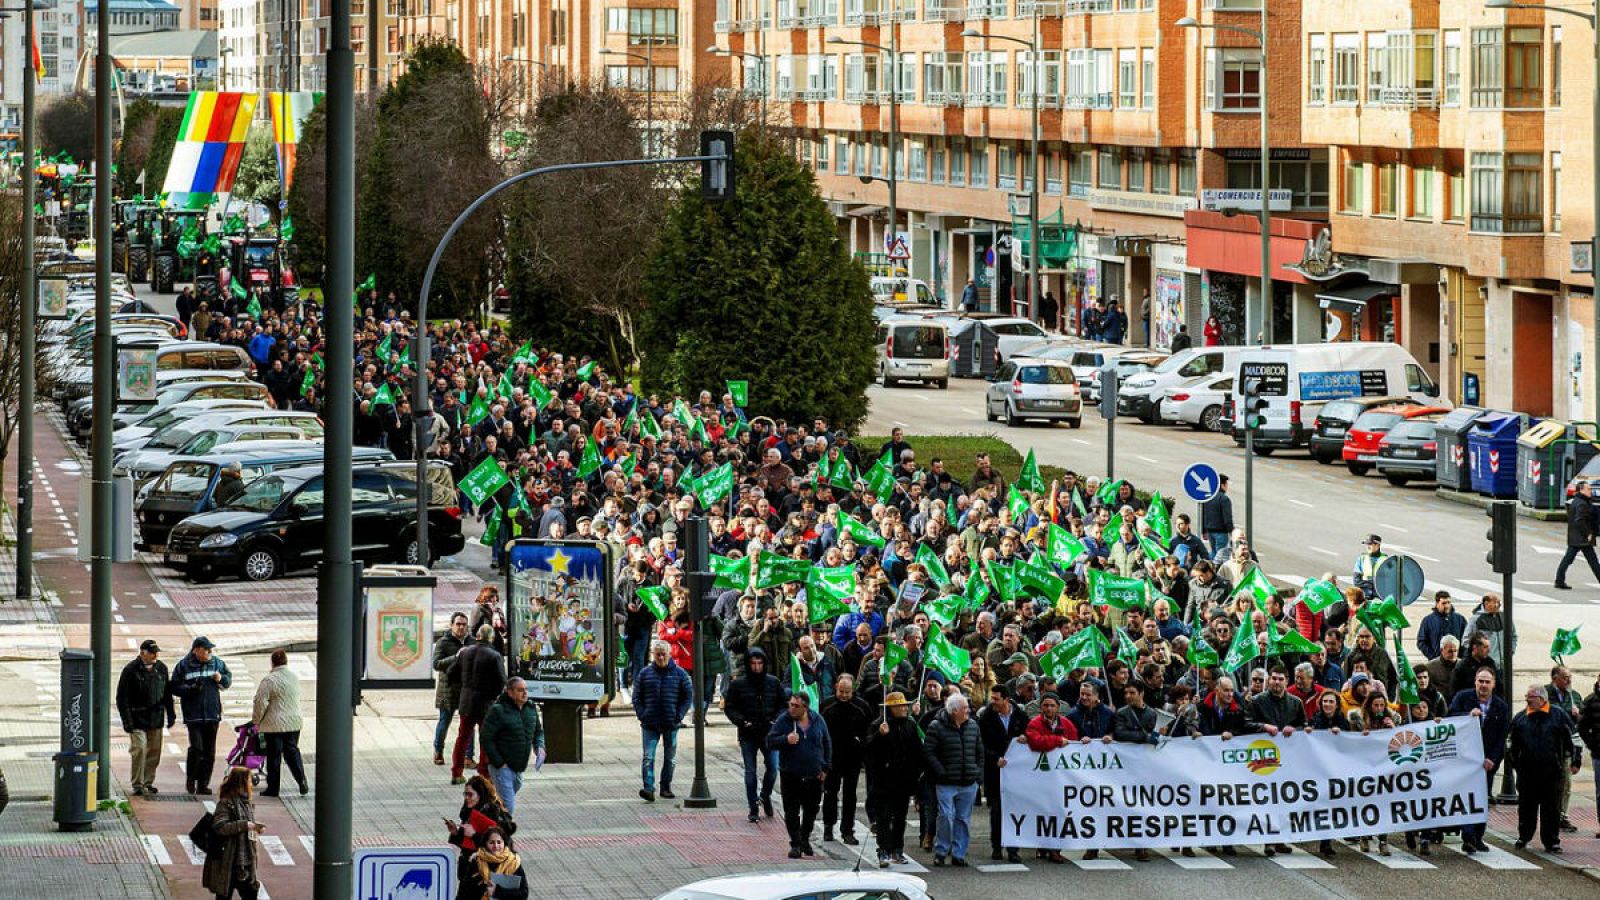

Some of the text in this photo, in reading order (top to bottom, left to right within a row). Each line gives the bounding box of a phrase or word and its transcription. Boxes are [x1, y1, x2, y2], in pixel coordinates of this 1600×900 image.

[1218, 191, 1290, 201] COMERCIO EERIOR
[1244, 365, 1286, 376] MADDECOR
[1425, 723, 1456, 741] UPA
[1055, 752, 1124, 770] ASAJA
[1223, 748, 1276, 762] COAG
[1064, 768, 1433, 808] POR UNOS PRECIOS DIGNOS
[1010, 791, 1484, 839] Y MÁS RESPETO AL MEDIO RURAL
